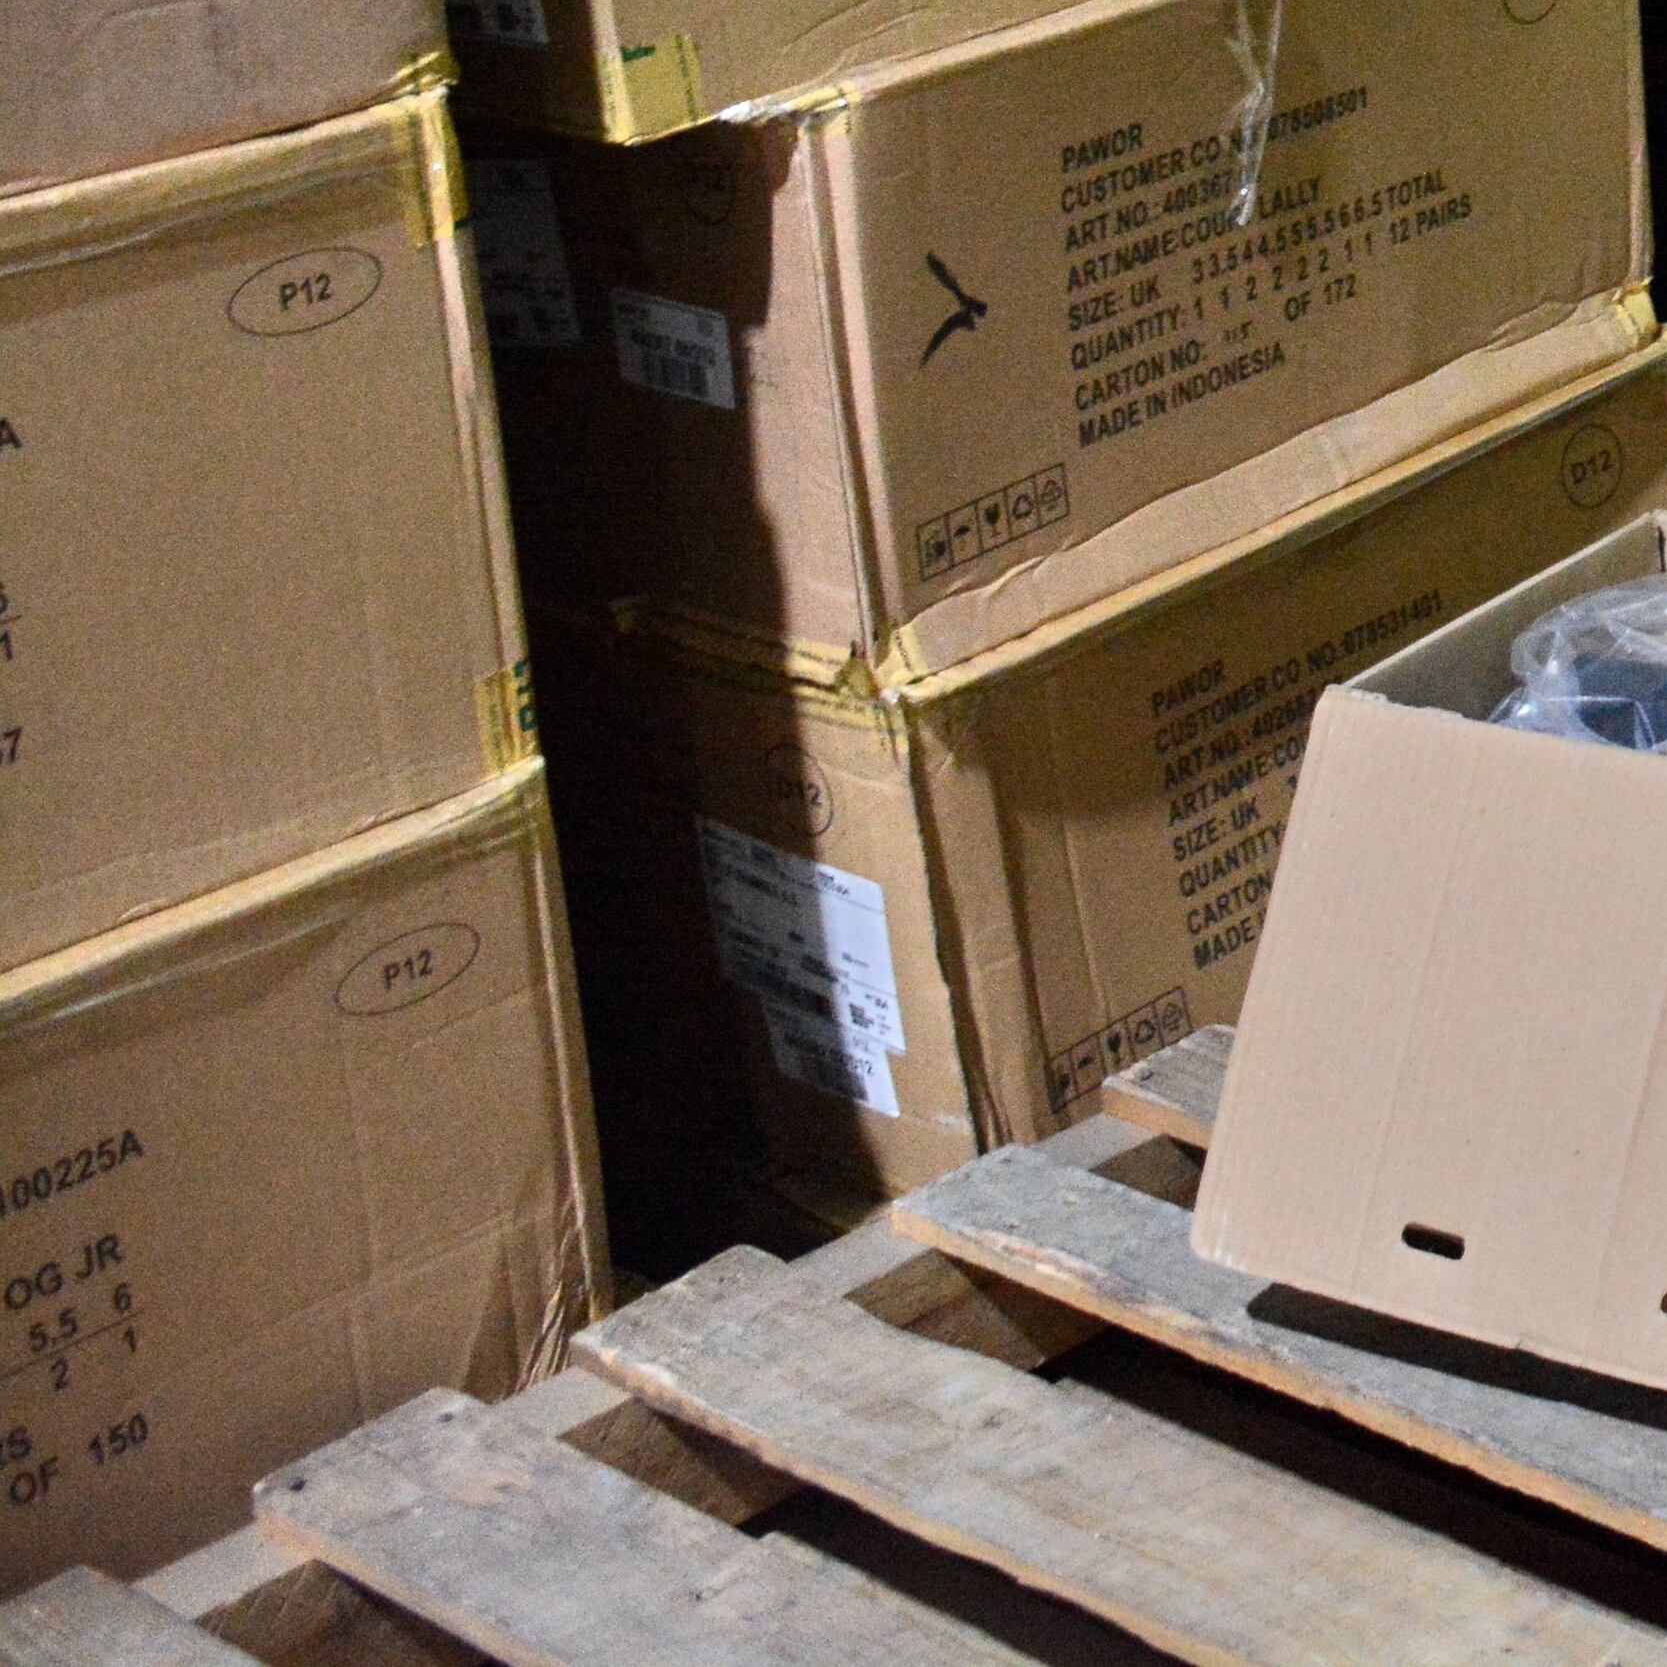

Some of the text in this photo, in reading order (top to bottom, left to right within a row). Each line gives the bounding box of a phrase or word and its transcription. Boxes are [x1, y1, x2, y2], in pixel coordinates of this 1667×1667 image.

[1060, 136, 1221, 214] CUSTOMER CO
[1061, 122, 1143, 174] PAWOR
[1414, 194, 1473, 236] PAIRS
[279, 272, 333, 314] P12
[1130, 276, 1161, 308] UK
[1075, 348, 1165, 412] CARTON
[1285, 294, 1312, 323] OF
[1323, 274, 1359, 308] 172
[1078, 342, 1286, 449] MADE IN INDONESIA
[1151, 659, 1225, 719] PAWOR
[1155, 675, 1268, 755] CUSTOMER
[1230, 797, 1262, 831] UK
[1187, 870, 1273, 937] CARTON
[382, 947, 435, 992] P12
[1193, 916, 1255, 970] MADE
[76, 1234, 123, 1281] JR
[29, 1283, 132, 1354] 5.5 6
[50, 1358, 69, 1391] 2
[9, 1457, 60, 1506] OF
[89, 1413, 148, 1465] 150
